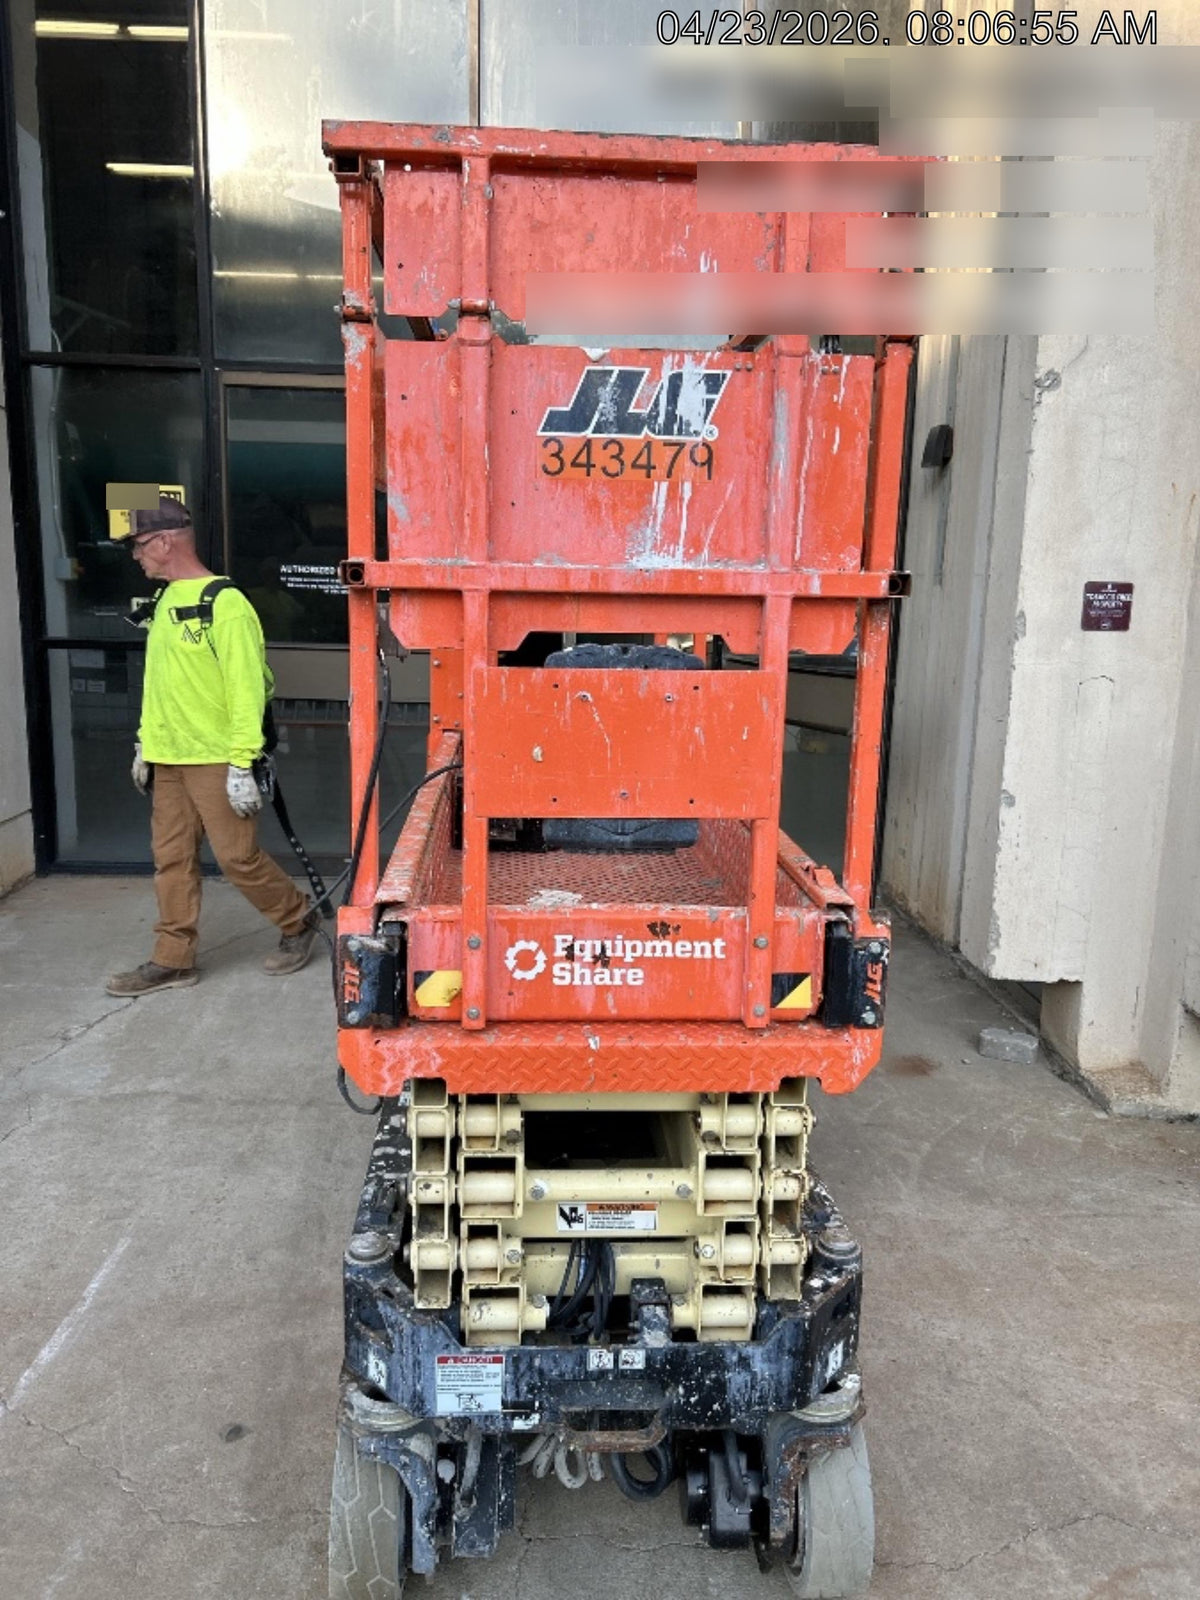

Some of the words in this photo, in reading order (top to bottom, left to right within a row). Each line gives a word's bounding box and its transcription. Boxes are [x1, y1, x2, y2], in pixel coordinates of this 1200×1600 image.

[541, 437, 714, 481] 343479
[552, 934, 727, 963] Equipment
[551, 963, 645, 986] Share
